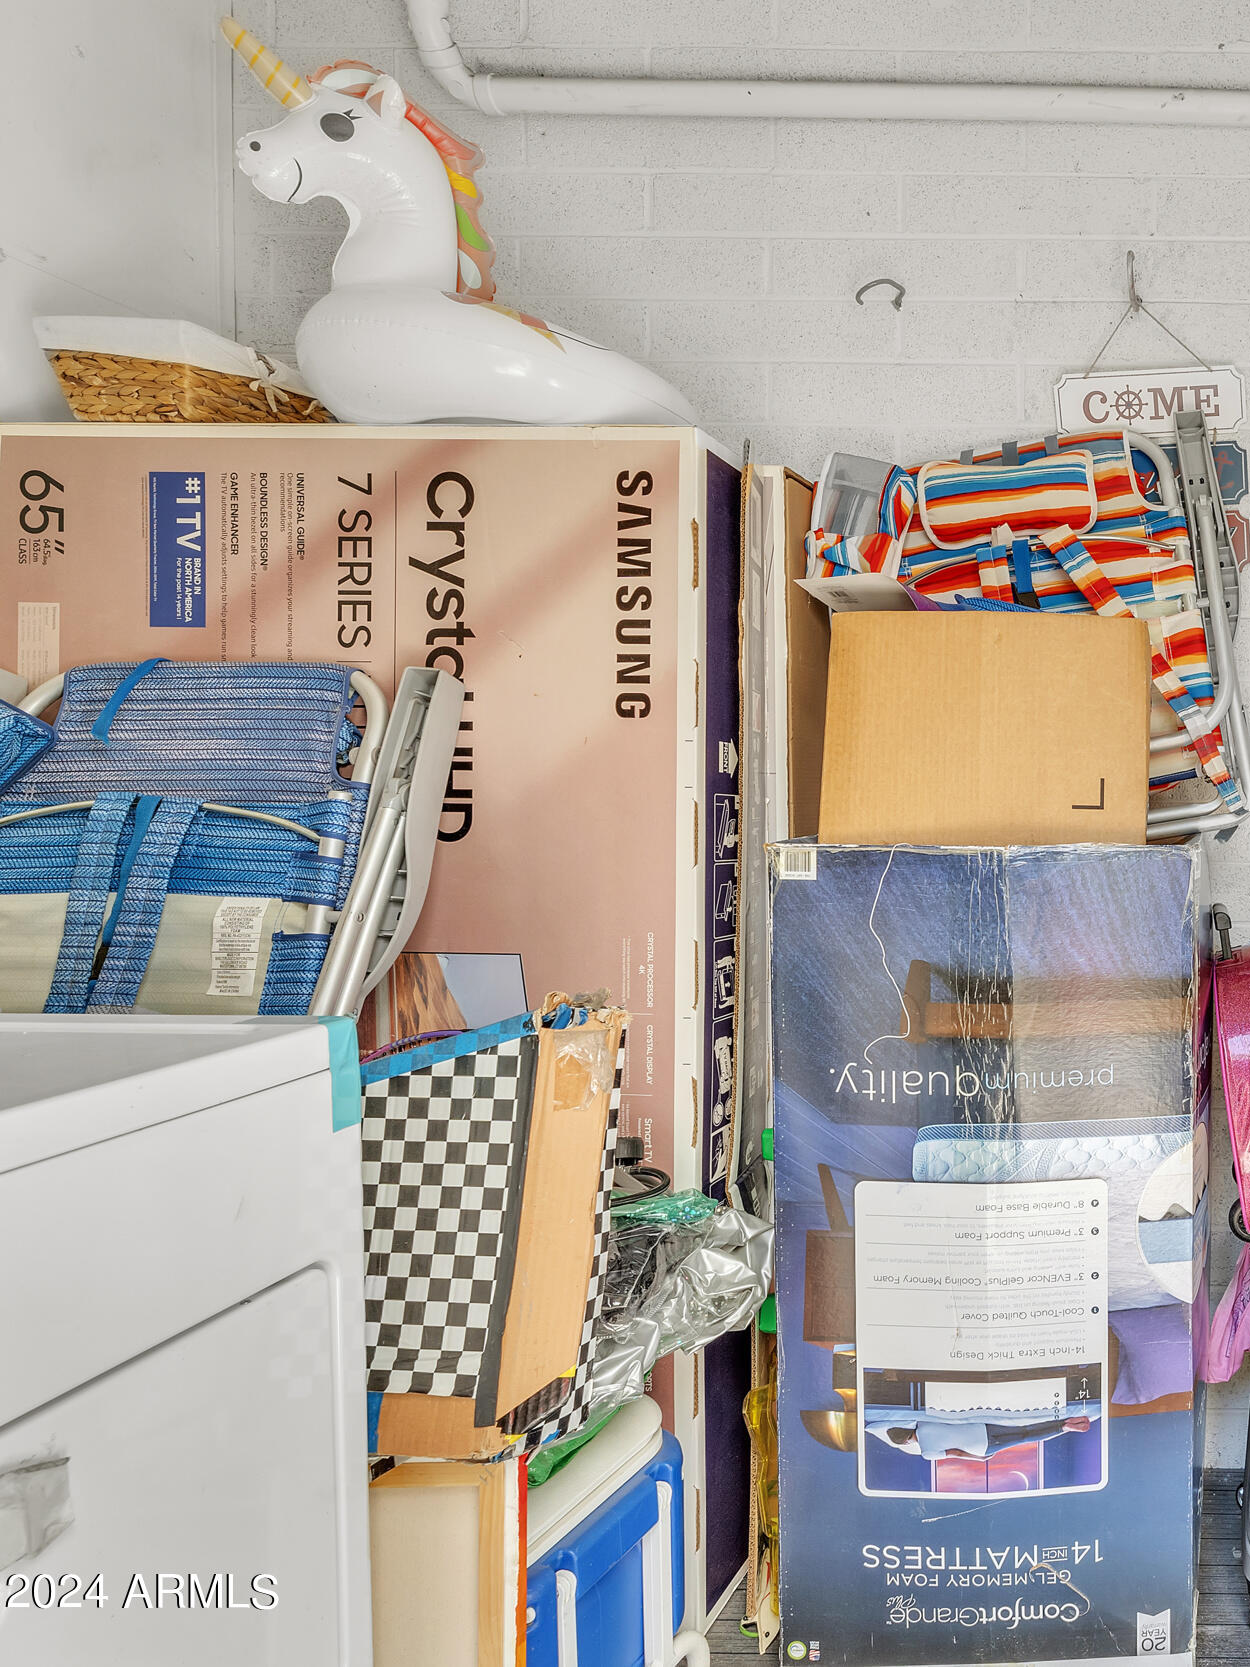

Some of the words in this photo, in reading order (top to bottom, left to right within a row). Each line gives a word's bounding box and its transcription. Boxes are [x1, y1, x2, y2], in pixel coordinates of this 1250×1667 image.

[1082, 384, 1220, 425] COME
[250, 472, 257, 482] An
[176, 477, 201, 504] #1
[220, 486, 227, 495] TV
[337, 473, 372, 496] 7
[297, 472, 305, 524] UNIVERSAL
[176, 512, 201, 551] TV
[250, 535, 257, 544] on
[19, 538, 27, 564] CLASS
[33, 552, 39, 562] cm
[337, 508, 372, 649] SERIES
[194, 586, 201, 595] IN
[408, 471, 476, 701] Crysta
[615, 470, 653, 719] SAMSUNG
[638, 965, 645, 975] 4K
[984, 1063, 1115, 1095] premium
[644, 1118, 652, 1148] Smart
[644, 1150, 652, 1163] TV
[975, 1204, 1003, 1213] Foam
[1006, 1203, 1030, 1212] Base
[1032, 1200, 1071, 1212] Durable
[955, 1231, 982, 1241] Foam
[985, 1231, 1025, 1241] Support
[1028, 1229, 1071, 1240] Premium
[873, 1275, 900, 1285] Foam
[903, 1274, 942, 1286] Memory
[944, 1275, 982, 1286] Cooling
[1027, 1273, 1071, 1284] EVENcor
[960, 1312, 989, 1322] Cover
[992, 1310, 1027, 1322] Quilted
[1030, 1307, 1084, 1320] Cool-Touch
[949, 1349, 984, 1361] Design
[987, 1350, 1014, 1360] Thick
[1018, 1348, 1046, 1359] Extra
[1049, 1345, 1086, 1356] 14-Inch
[861, 1543, 1038, 1570] MATTRESS
[1042, 1548, 1067, 1560] INCH
[1071, 1538, 1104, 1566] 14
[886, 1572, 939, 1587] FOAM
[945, 1572, 1027, 1587] MEMORY
[1036, 1568, 1072, 1585] GEL
[886, 1593, 916, 1610] Plus
[1141, 1626, 1166, 1638] YEAR
[1141, 1635, 1166, 1652] 20
